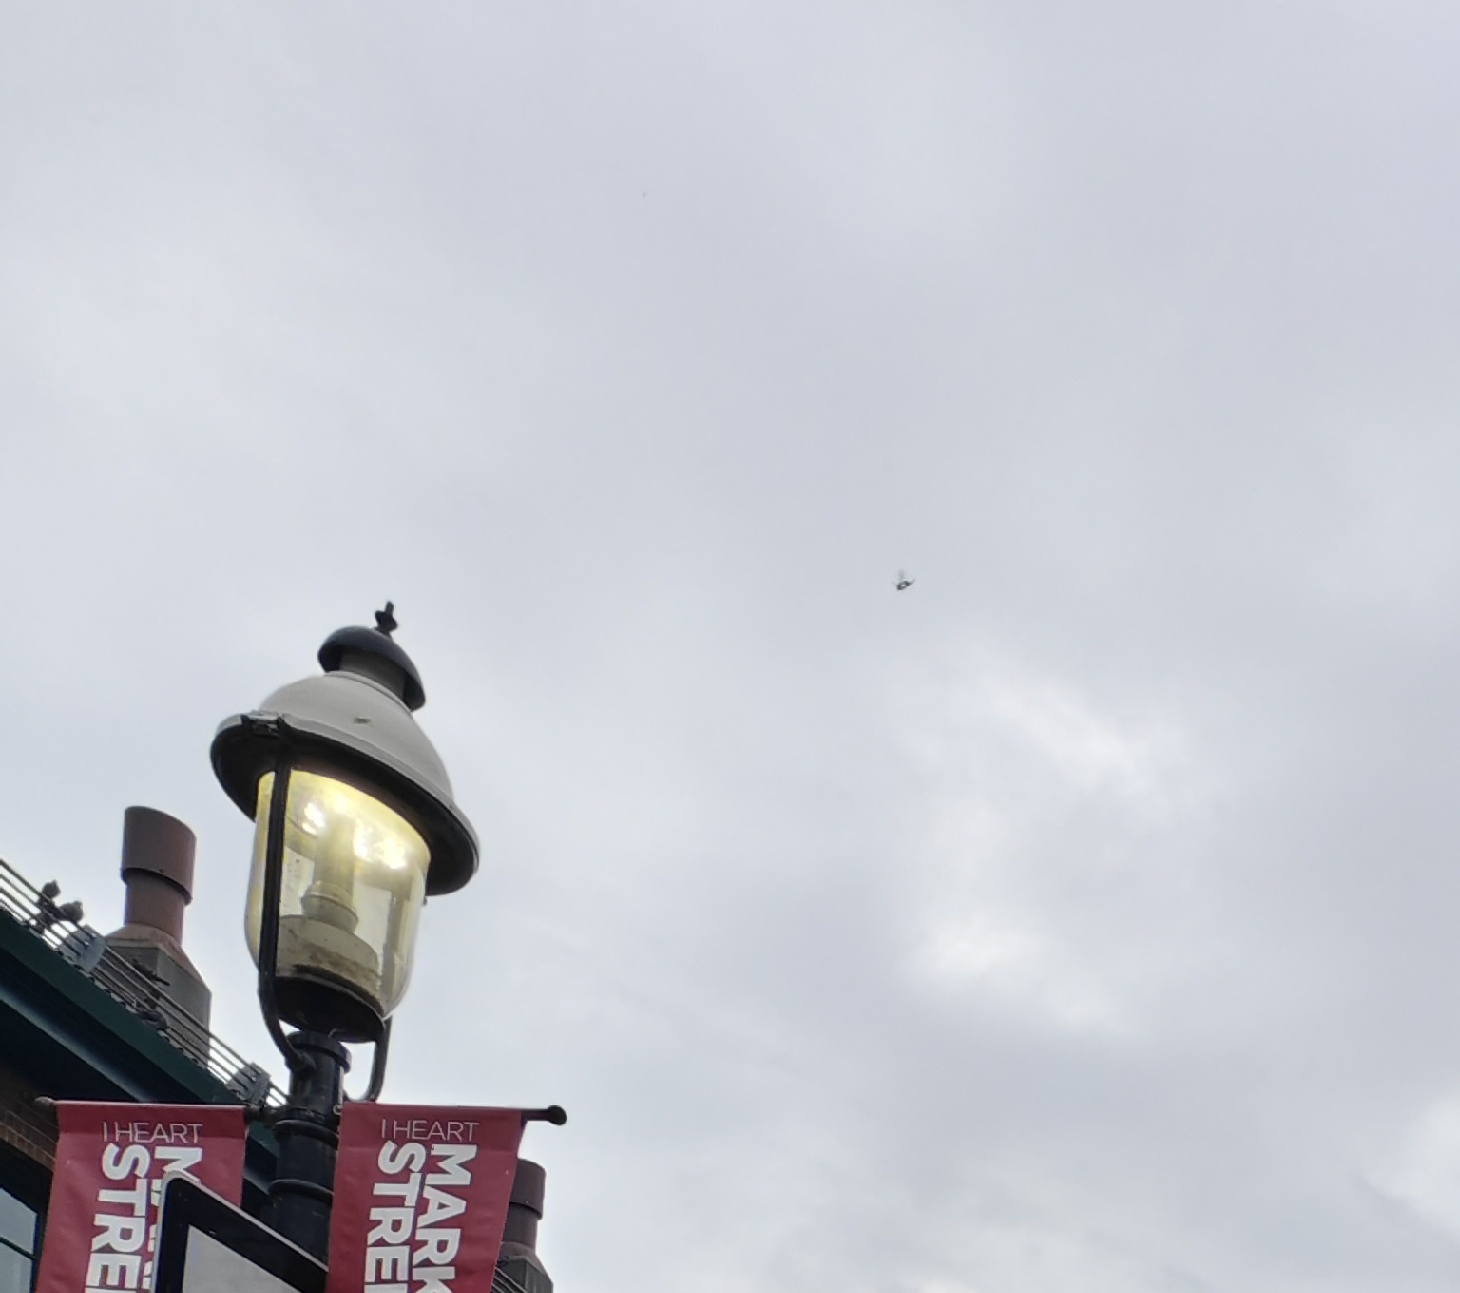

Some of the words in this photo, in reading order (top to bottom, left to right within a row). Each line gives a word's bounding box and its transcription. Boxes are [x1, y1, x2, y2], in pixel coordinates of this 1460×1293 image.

[103, 1122, 109, 1142] I
[115, 1122, 203, 1144] HEART
[380, 1119, 387, 1140] I
[394, 1119, 480, 1142] HEART
